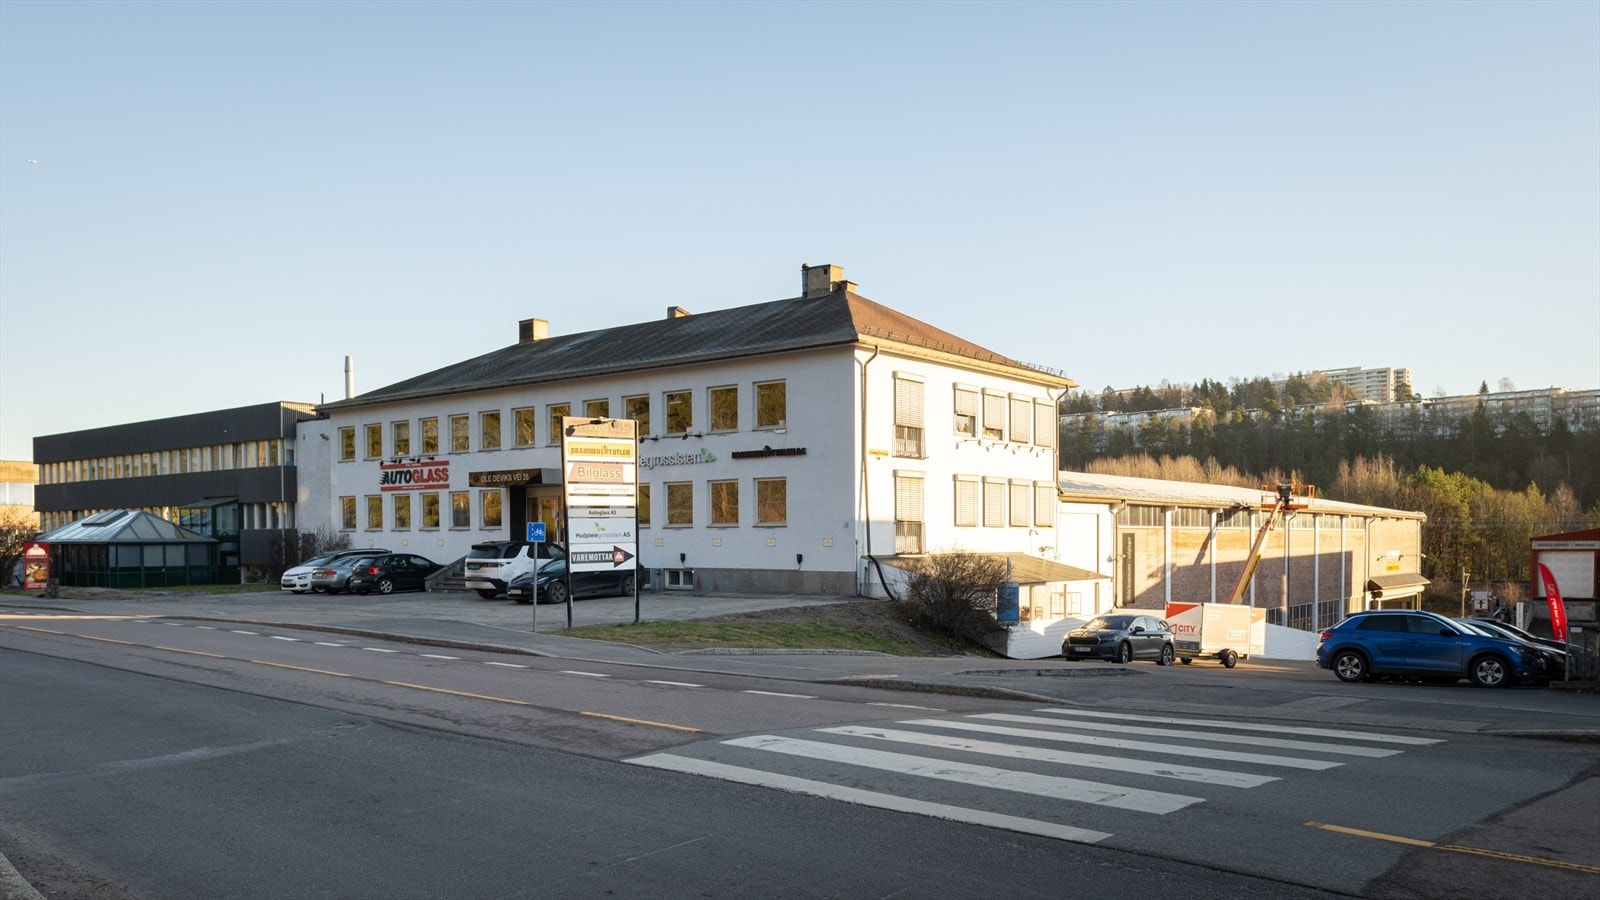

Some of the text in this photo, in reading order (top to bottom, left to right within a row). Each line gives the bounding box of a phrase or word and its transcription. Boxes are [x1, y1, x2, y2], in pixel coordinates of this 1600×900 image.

[380, 466, 449, 485] AUTOGLASS
[480, 473, 530, 483] OLE DEVIKS VEI 26
[577, 466, 621, 480] Bilglass
[572, 553, 614, 562] VAREMOTTAK
[1178, 624, 1196, 633] CITY
